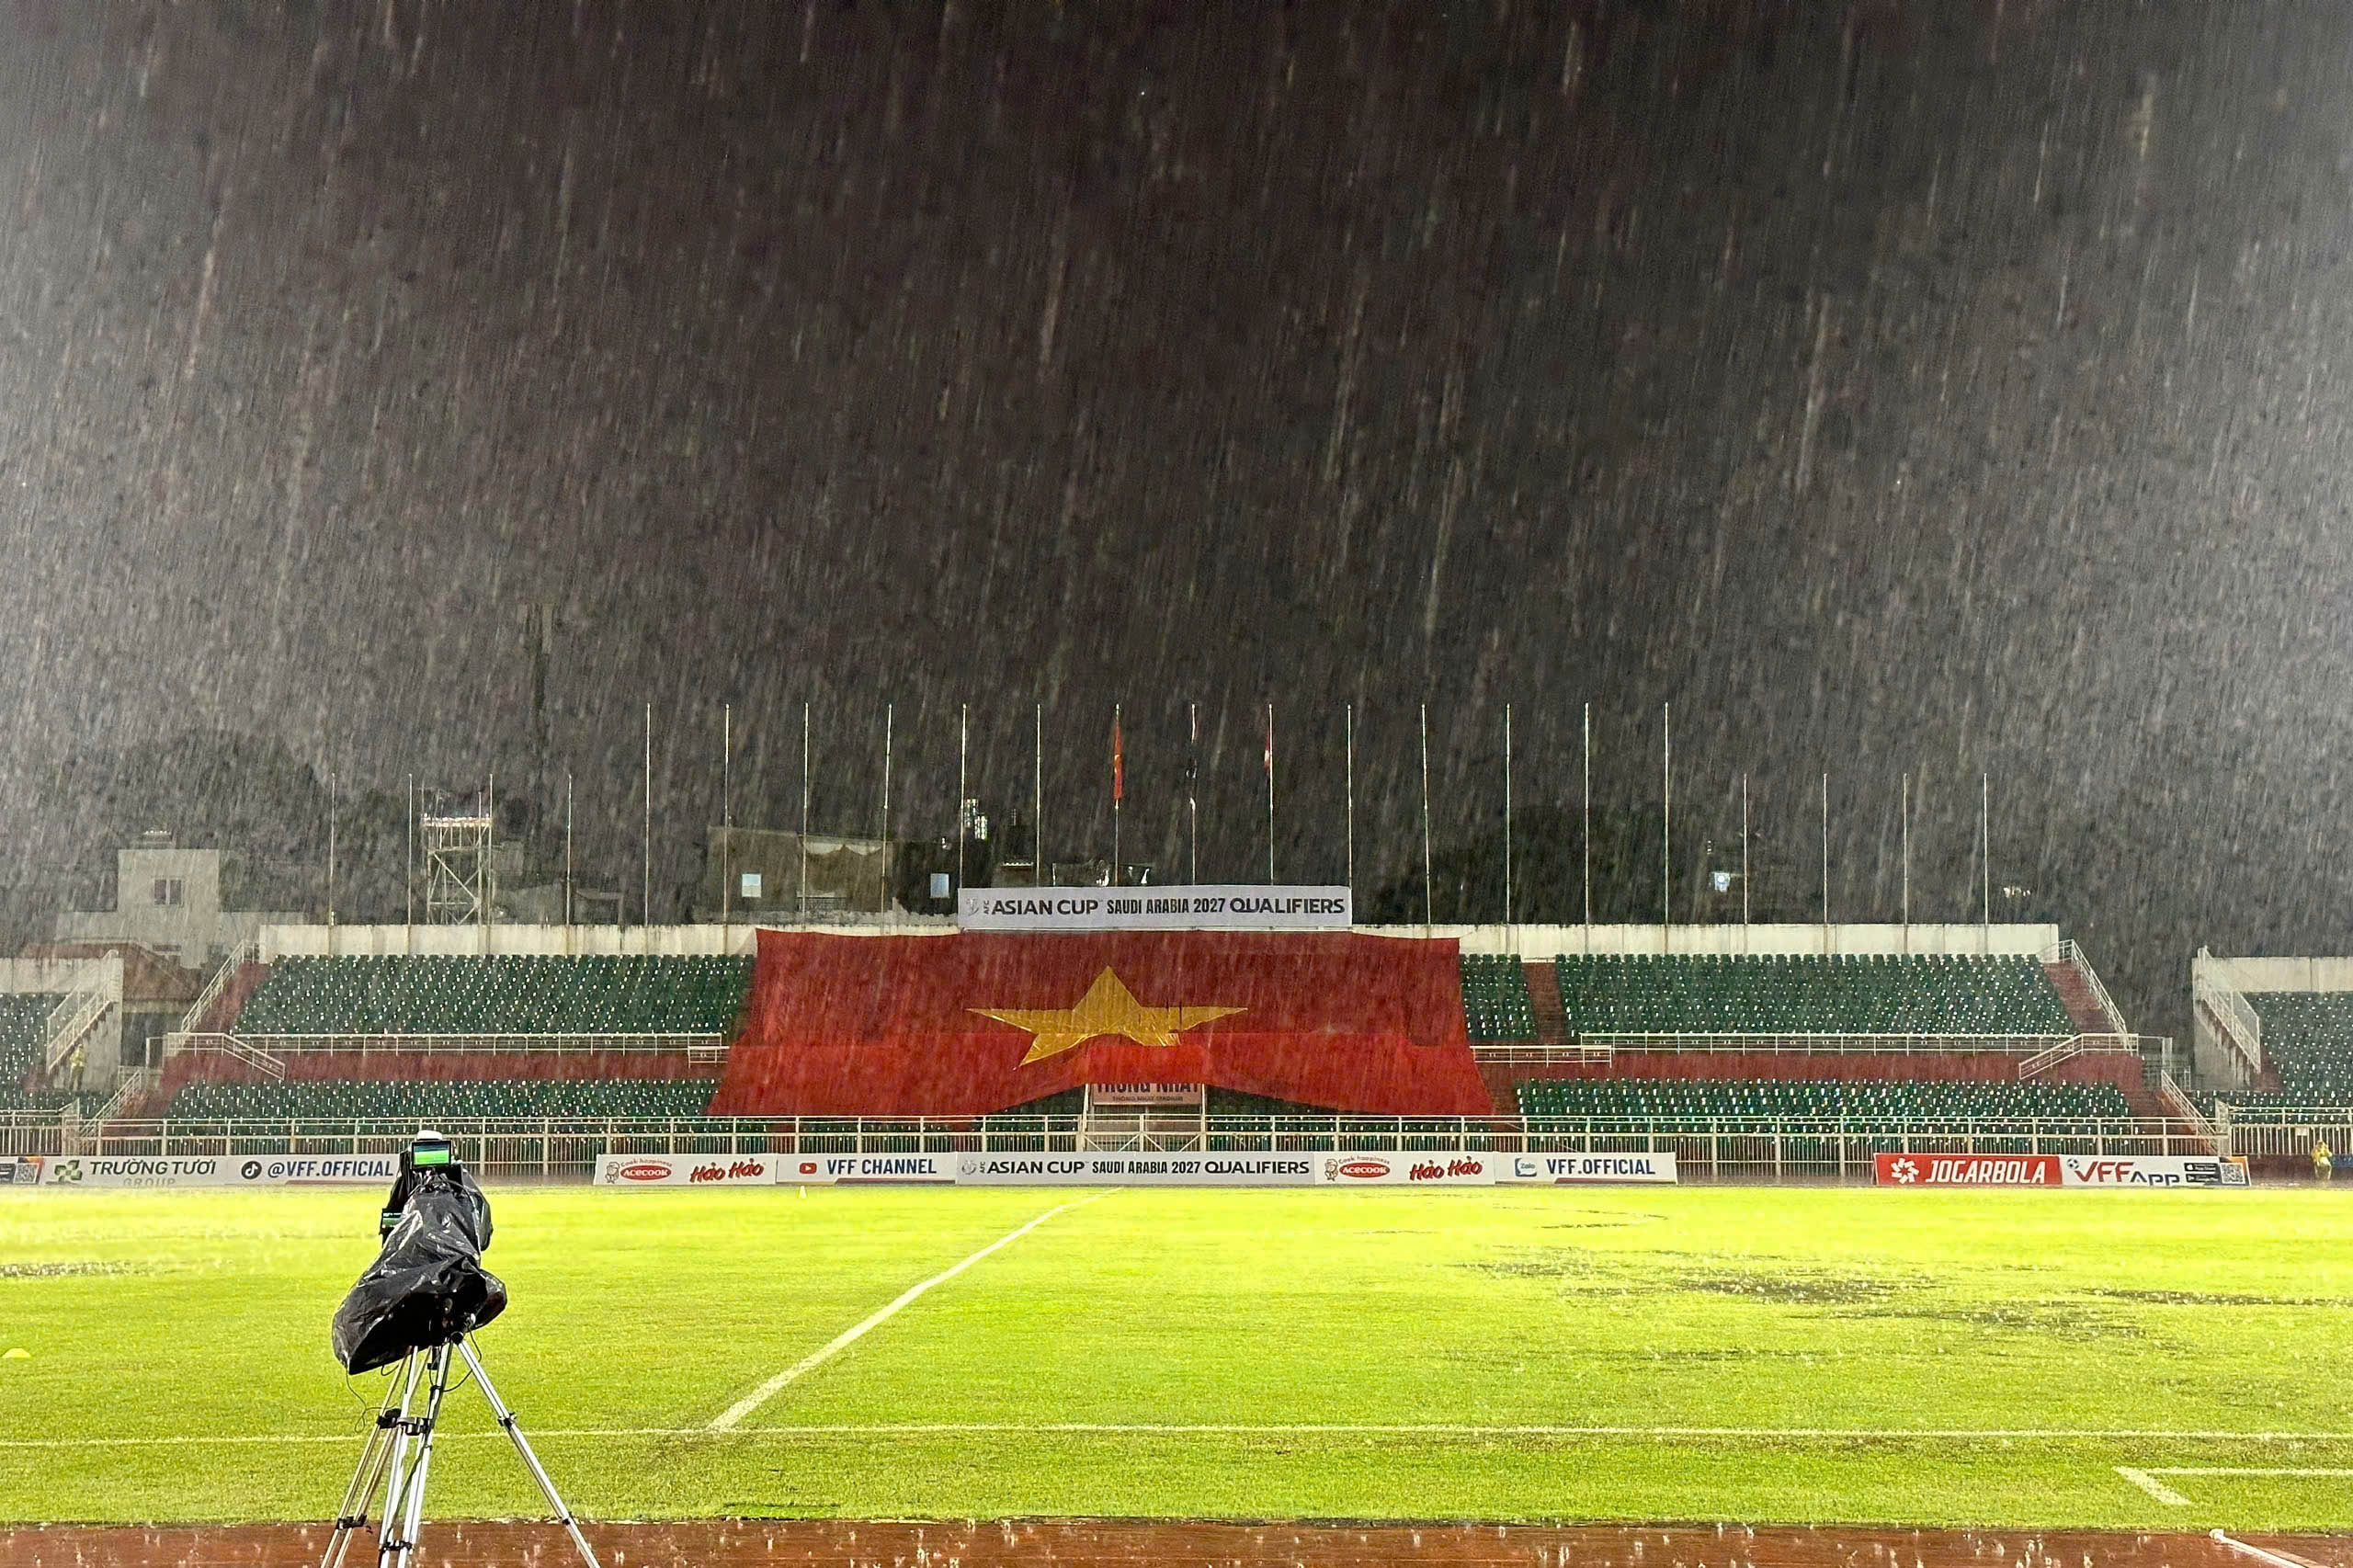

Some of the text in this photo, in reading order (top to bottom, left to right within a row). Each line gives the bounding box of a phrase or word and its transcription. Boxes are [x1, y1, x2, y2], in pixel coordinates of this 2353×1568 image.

[992, 897, 1346, 915] ASIAN CUP SAUDI ARABIA 2027 QUALIFIERS
[90, 1158, 217, 1176] TRƯỜNG TƯƠI
[267, 1161, 393, 1177] @VFF.OFFICIAL
[827, 1159, 937, 1175] VFF CHANNEL
[987, 1161, 1310, 1174] ASIAN CUP SAUDI ARABIA 2027 QUALIFIERS
[1546, 1159, 1655, 1175] VFF.OFFICIAL
[1926, 1160, 2046, 1184] JOGARBOLA
[2075, 1161, 2134, 1182] VFF
